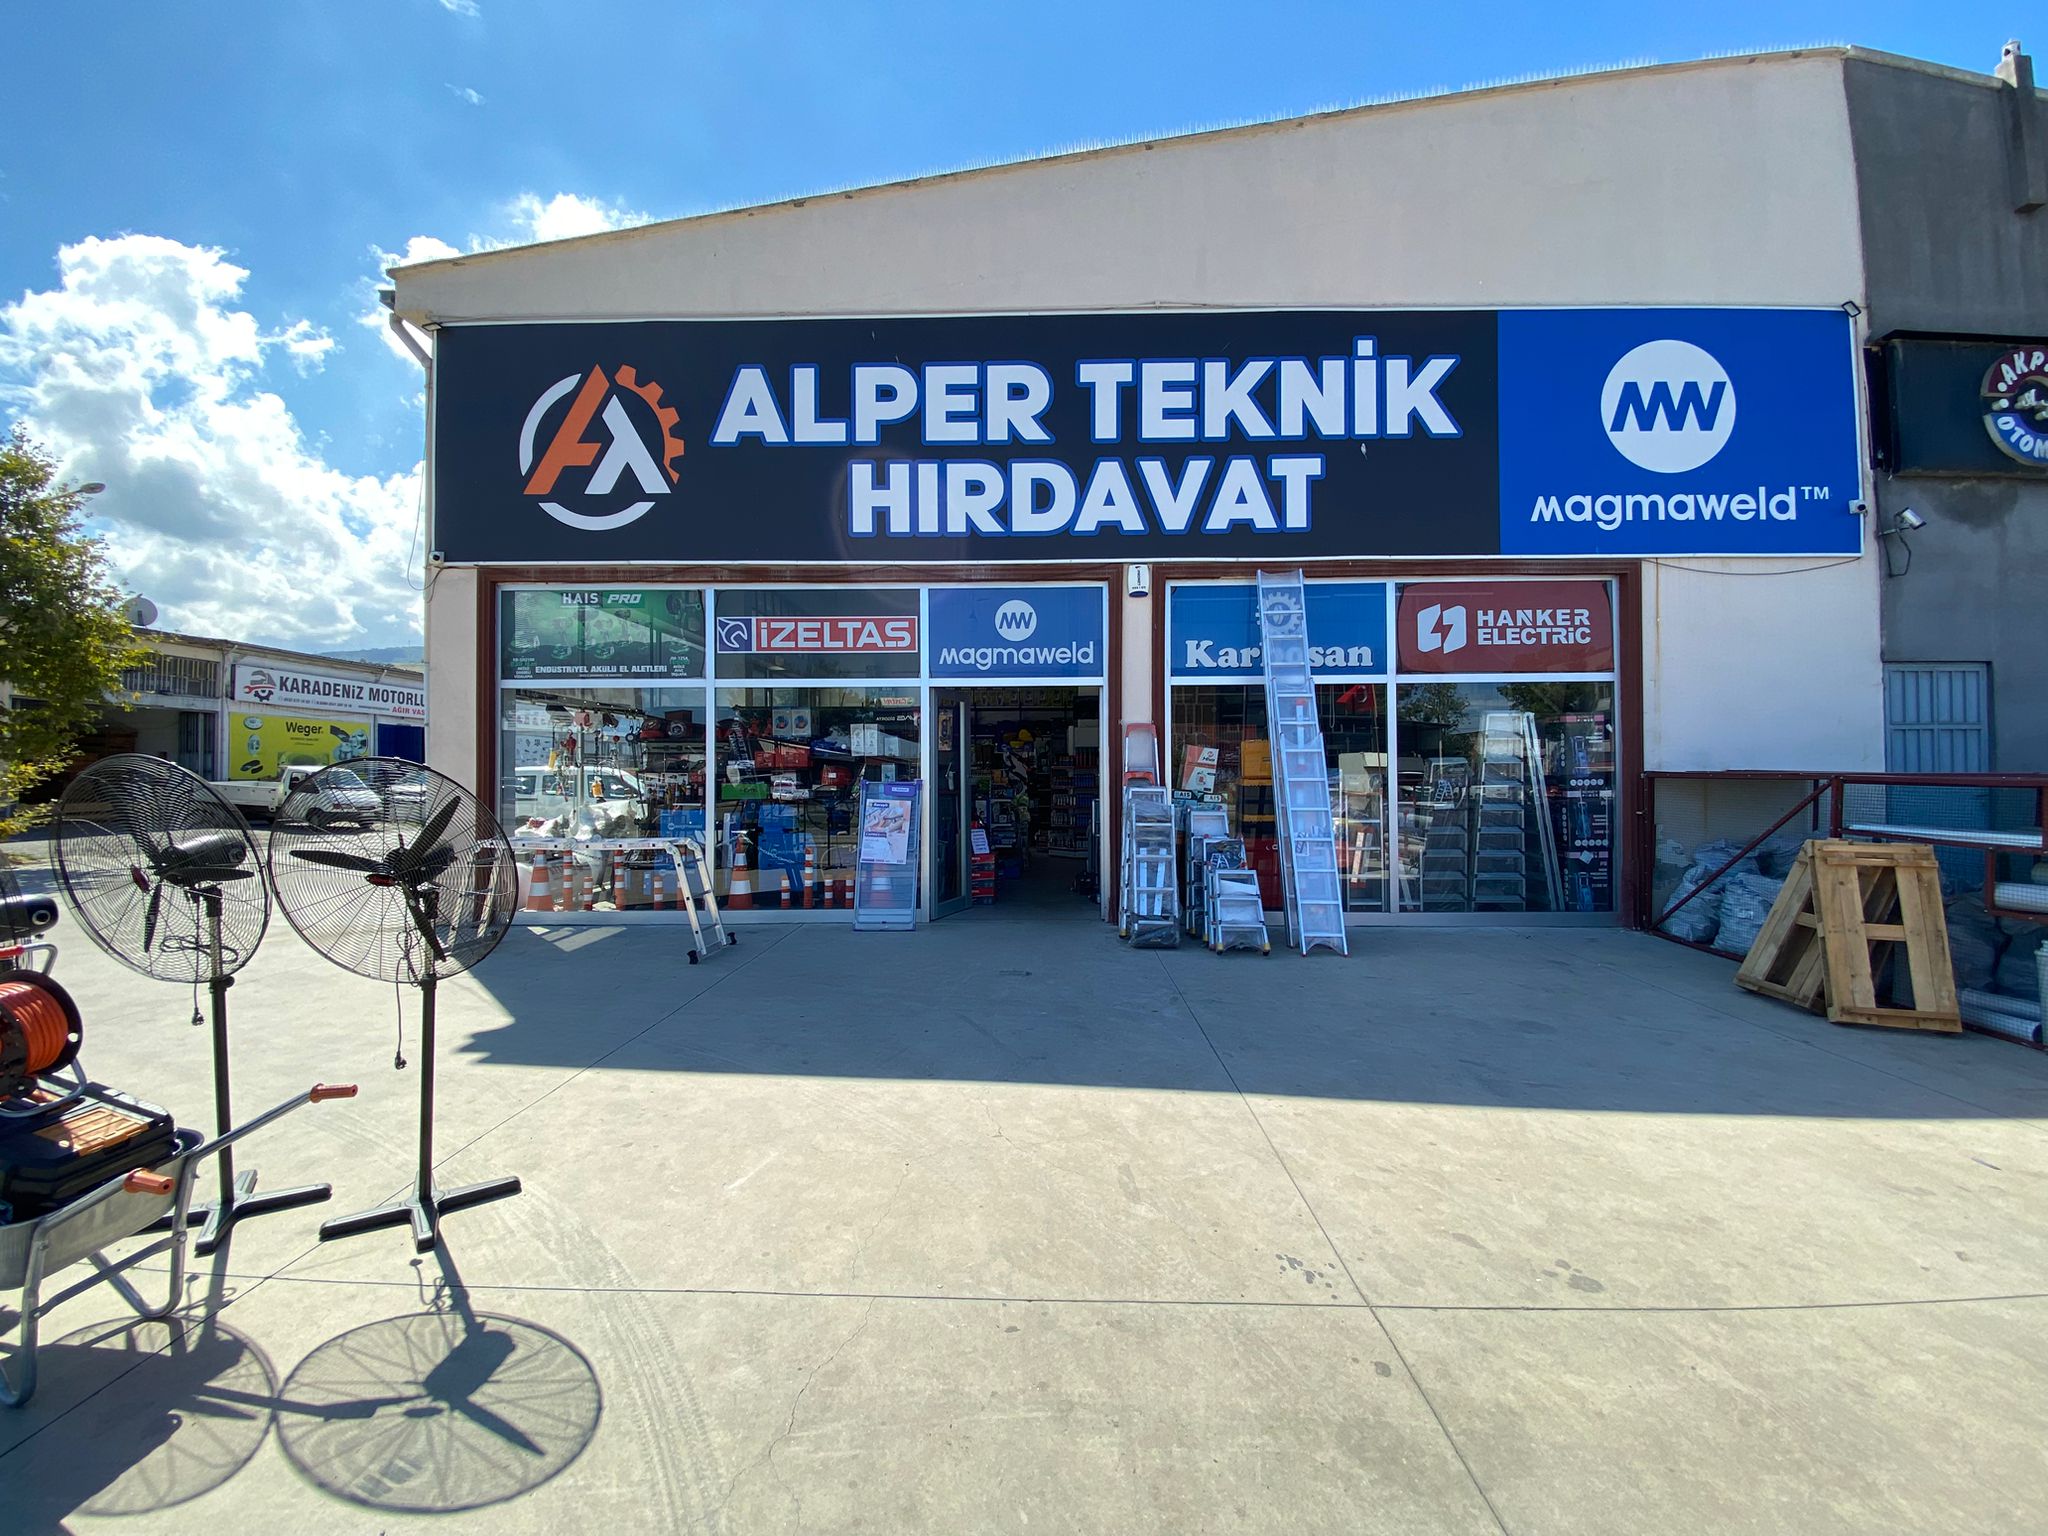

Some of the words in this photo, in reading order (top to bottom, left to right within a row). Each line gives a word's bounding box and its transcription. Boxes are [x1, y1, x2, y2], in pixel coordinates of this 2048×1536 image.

[2000, 350, 2048, 385] AKP
[710, 361, 1054, 445] ALPER
[1076, 336, 1462, 443] TEKNİK
[849, 454, 1325, 537] HIRDAVAT
[563, 592, 599, 604] HAIS
[607, 592, 642, 604] PRO
[1477, 608, 1591, 626] HANKER
[590, 664, 617, 674] AKÜLÜ
[619, 664, 629, 673] EL
[286, 721, 322, 737] Weger
